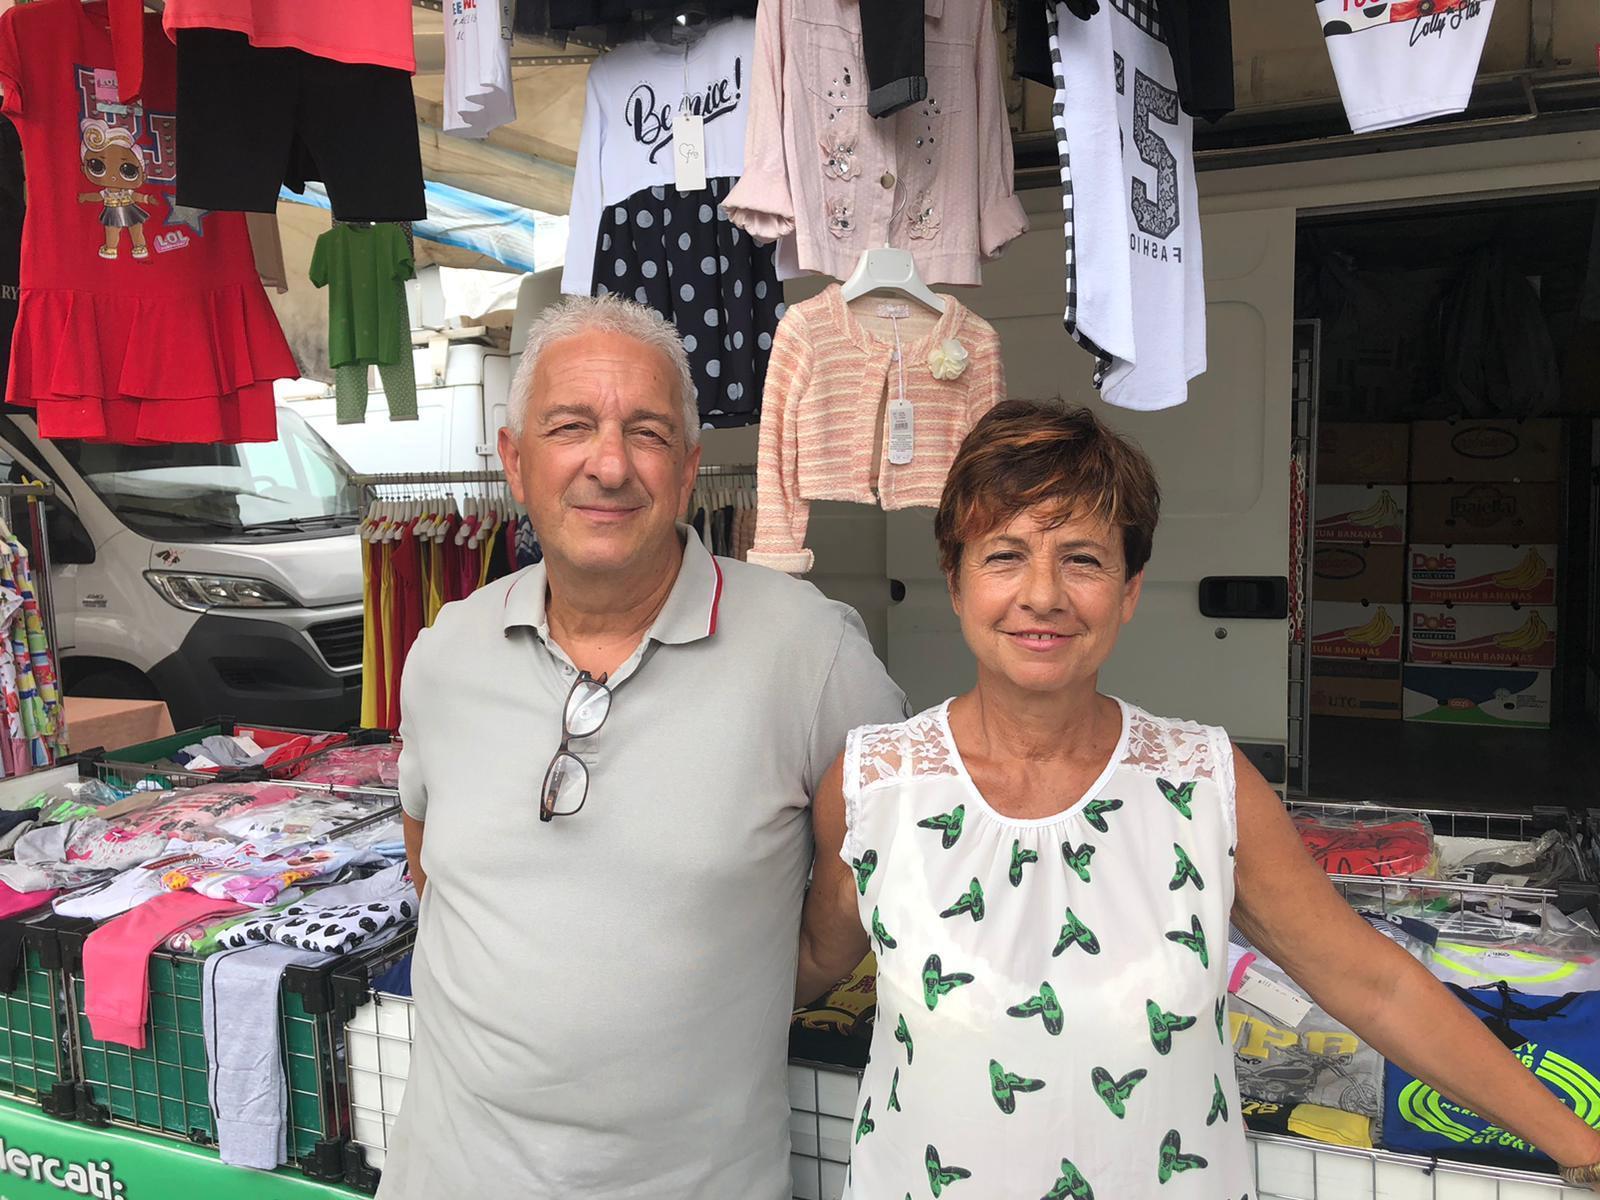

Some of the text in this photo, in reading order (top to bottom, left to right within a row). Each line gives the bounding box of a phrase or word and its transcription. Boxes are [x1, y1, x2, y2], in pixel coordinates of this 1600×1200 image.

[1410, 15, 1447, 48] Lolly
[625, 84, 672, 145] Be
[1337, 529, 1384, 539] BANANAS
[1429, 590, 1533, 602] PREMIUM BANANAS
[1335, 646, 1382, 657] BANANAS
[1430, 650, 1534, 663] PREMIUM BANANAS
[0, 1138, 124, 1200] ercati:
